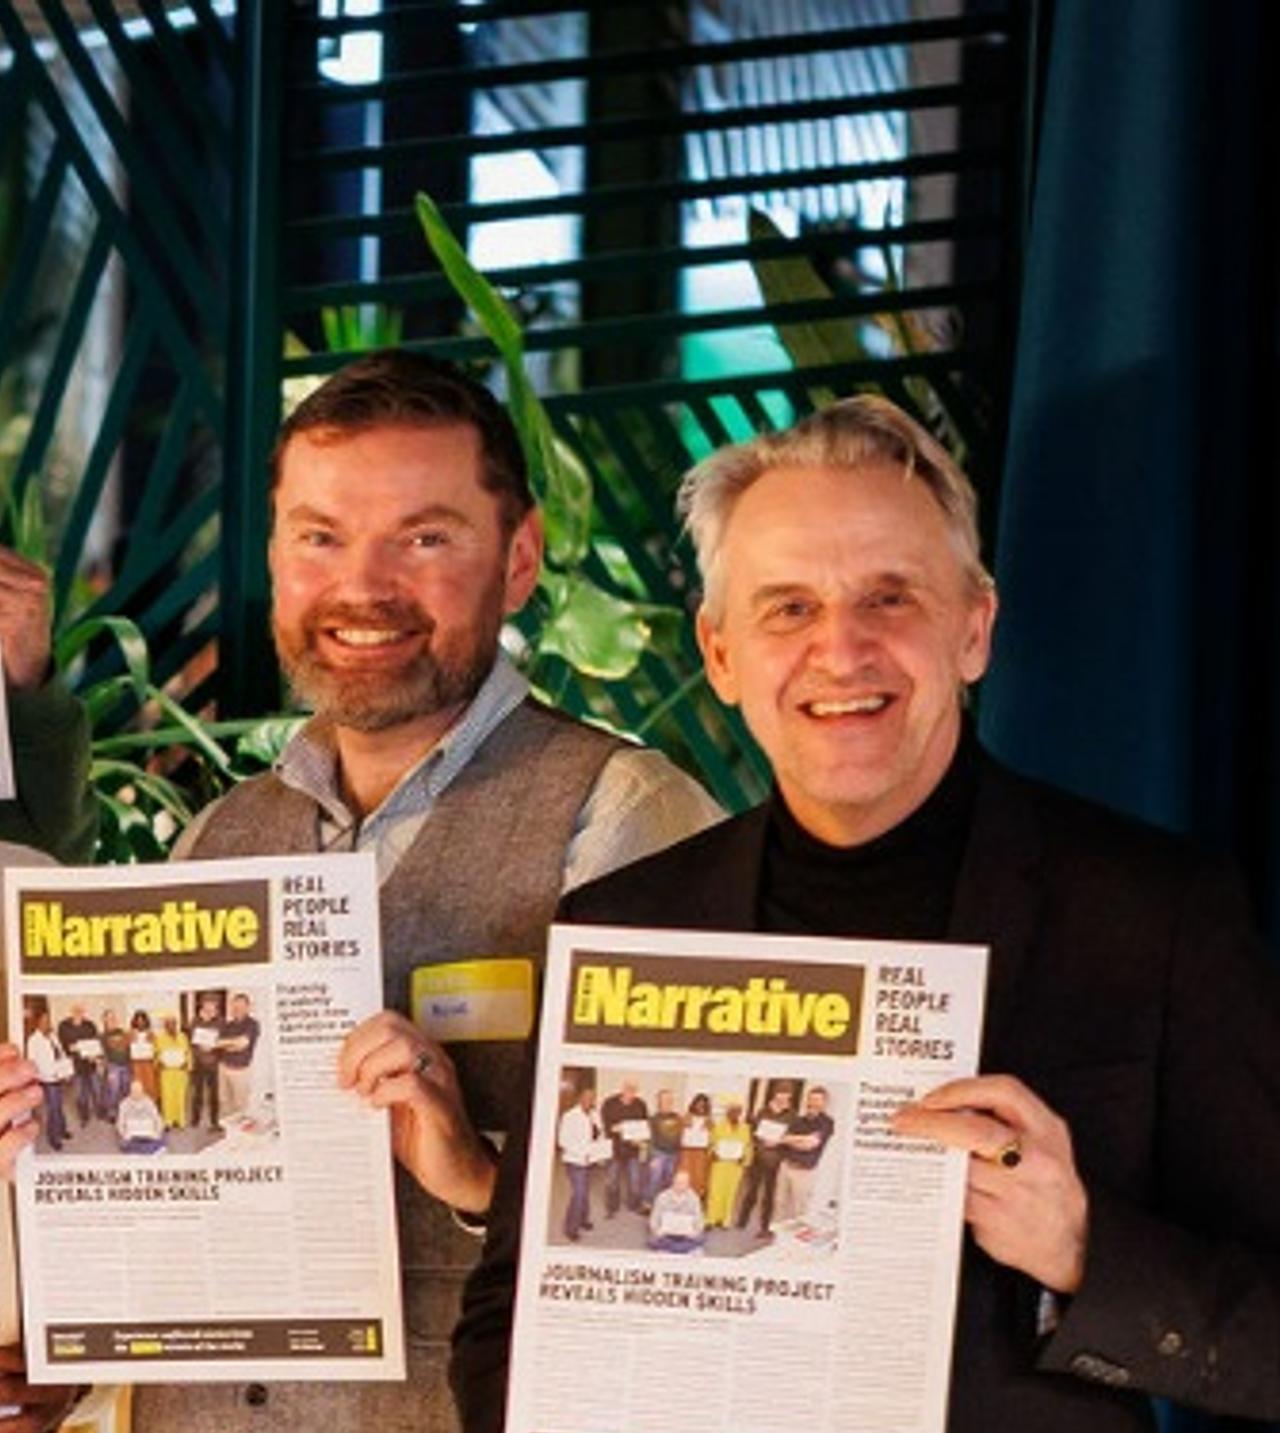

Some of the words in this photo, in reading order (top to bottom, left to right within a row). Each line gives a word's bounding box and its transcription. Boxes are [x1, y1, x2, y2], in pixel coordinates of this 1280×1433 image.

[283, 874, 325, 894] REAL
[283, 895, 351, 916] PEOPLE
[34, 901, 260, 958] Narrative
[283, 918, 328, 937] REAL
[283, 940, 360, 960] STORIES
[878, 966, 926, 987] REAL
[593, 966, 851, 1039] Narrative
[876, 989, 951, 1013] PEOPLE
[875, 1012, 922, 1034] REAL
[873, 1037, 955, 1061] STORIES
[35, 1169, 132, 1186] JOURNALISM
[137, 1168, 209, 1185] TRAINING
[213, 1165, 283, 1182] PROJECT
[34, 1187, 104, 1204] REVEALS
[108, 1186, 165, 1202] HIDDEN
[168, 1185, 220, 1201] SKILLS
[542, 1263, 655, 1286] JOURNALISM
[662, 1271, 747, 1293] TRAINING
[752, 1276, 835, 1301] PROJECT
[540, 1282, 617, 1303] REVEALS
[622, 1288, 690, 1308] HIDDEN
[695, 1293, 757, 1315] SKILLS
